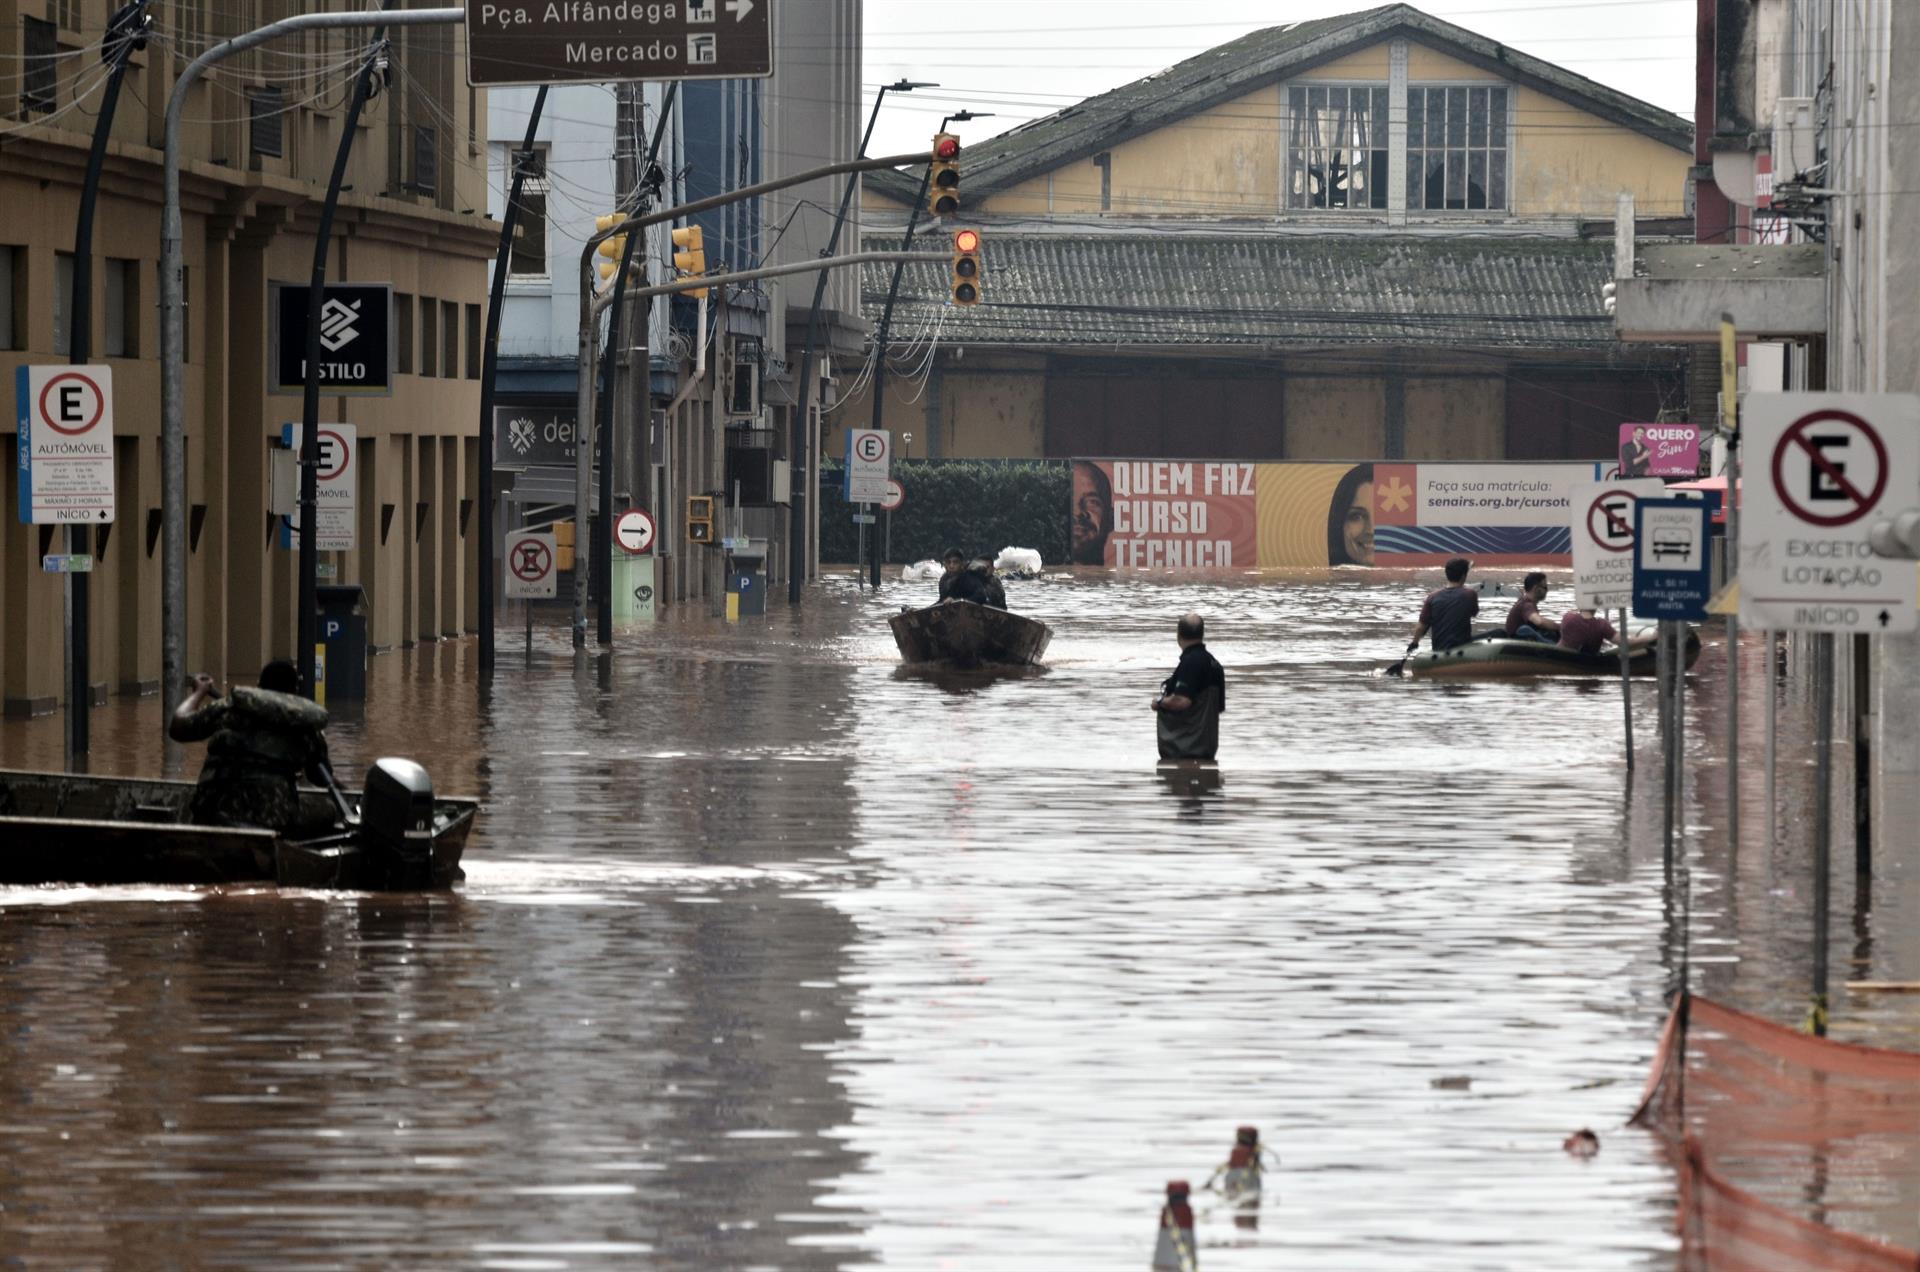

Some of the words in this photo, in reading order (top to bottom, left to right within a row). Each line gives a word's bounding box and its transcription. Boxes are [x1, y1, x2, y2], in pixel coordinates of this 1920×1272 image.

[482, 4, 533, 29] Pça.
[543, 0, 677, 24] Alfândega
[566, 40, 678, 63] Mercado
[60, 387, 83, 421] E
[1646, 428, 1695, 441] QUERO
[865, 440, 876, 456] E
[1810, 435, 1850, 500] E
[1113, 462, 1193, 497] QUEM
[1204, 463, 1255, 496] FAZ
[1428, 480, 1458, 493] Faça
[1461, 483, 1484, 492] sua
[1487, 480, 1552, 492] matrícula:
[1114, 500, 1207, 534] CURSO
[1112, 531, 1232, 568] TÉCNICO
[1786, 540, 1873, 559] EXCETO
[741, 577, 750, 589] P
[1781, 565, 1883, 589] LOTAÇÃO
[1794, 604, 1860, 626] INÍCIO
[327, 621, 339, 637] P
